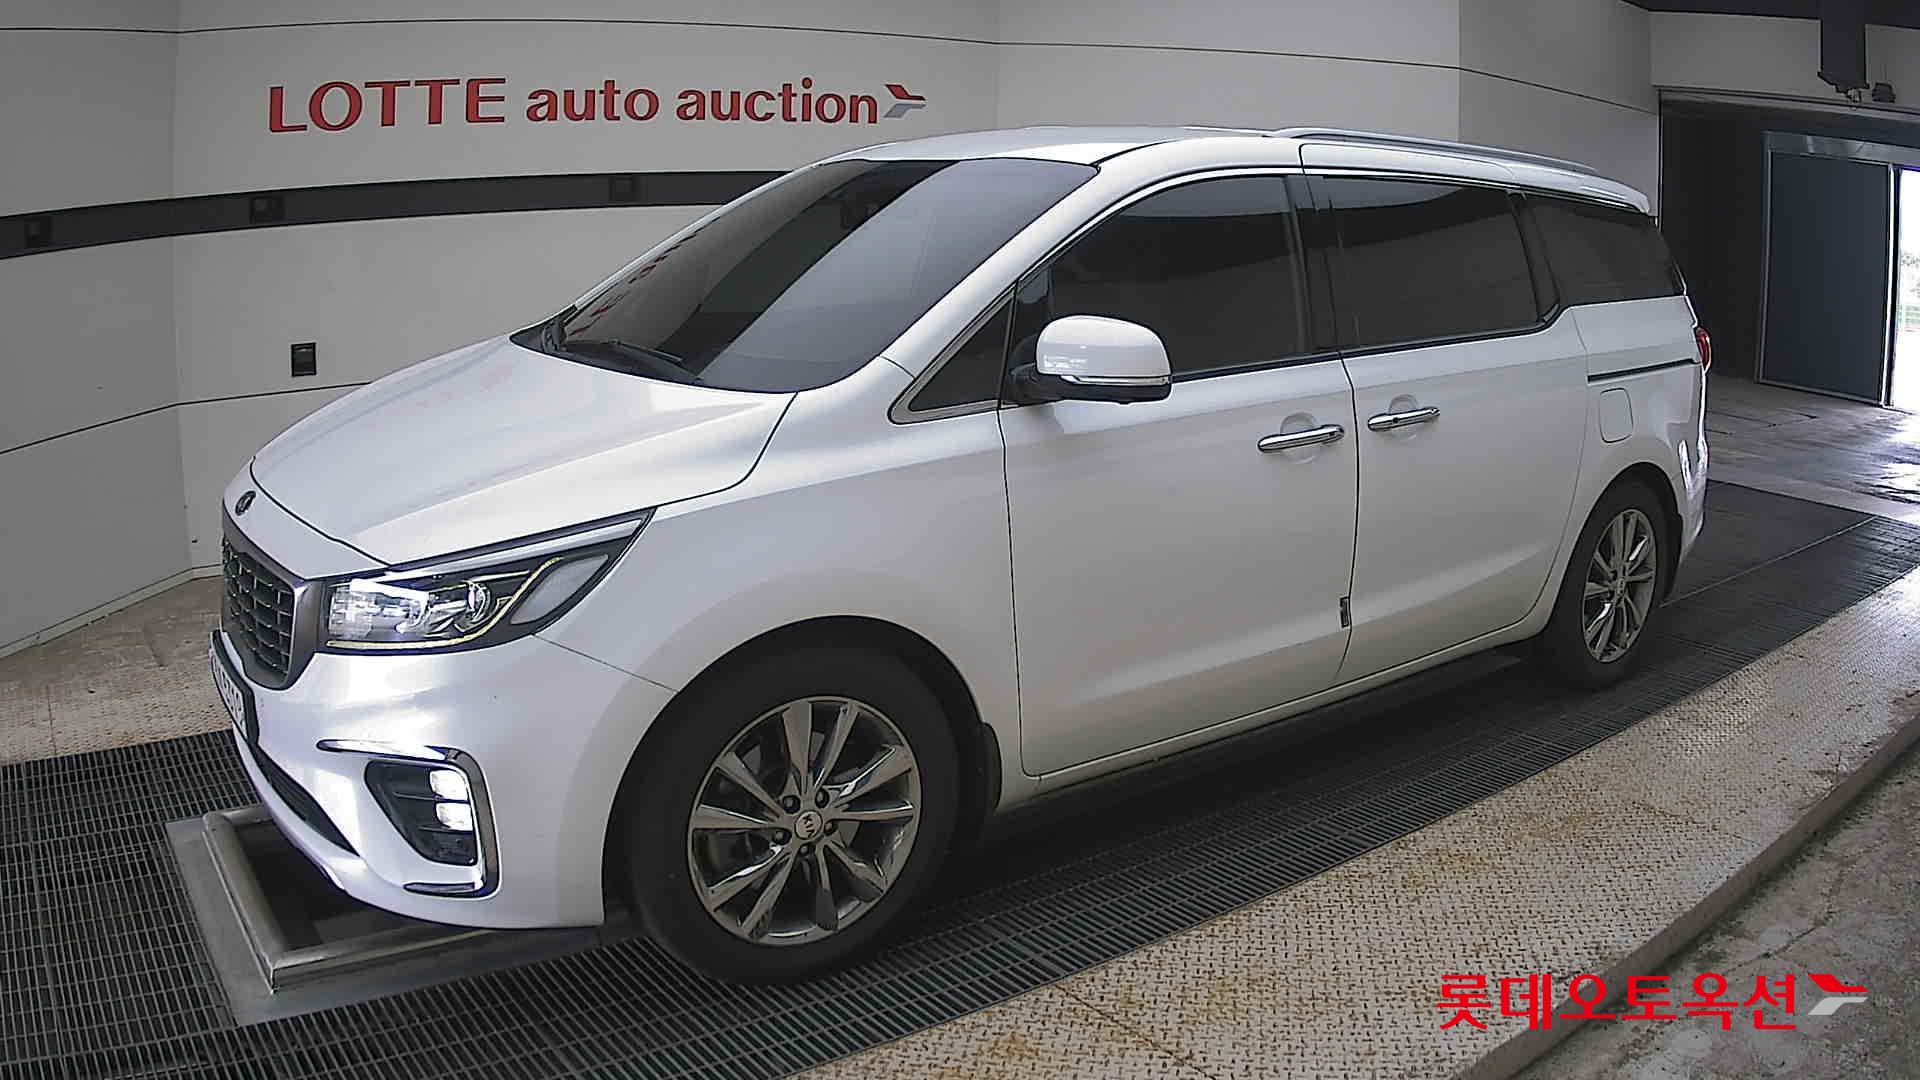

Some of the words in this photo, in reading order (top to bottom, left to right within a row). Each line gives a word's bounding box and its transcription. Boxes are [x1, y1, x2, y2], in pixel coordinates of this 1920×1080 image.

[269, 78, 506, 133] LOTTE
[526, 79, 660, 122] auto
[676, 77, 878, 124] auction
